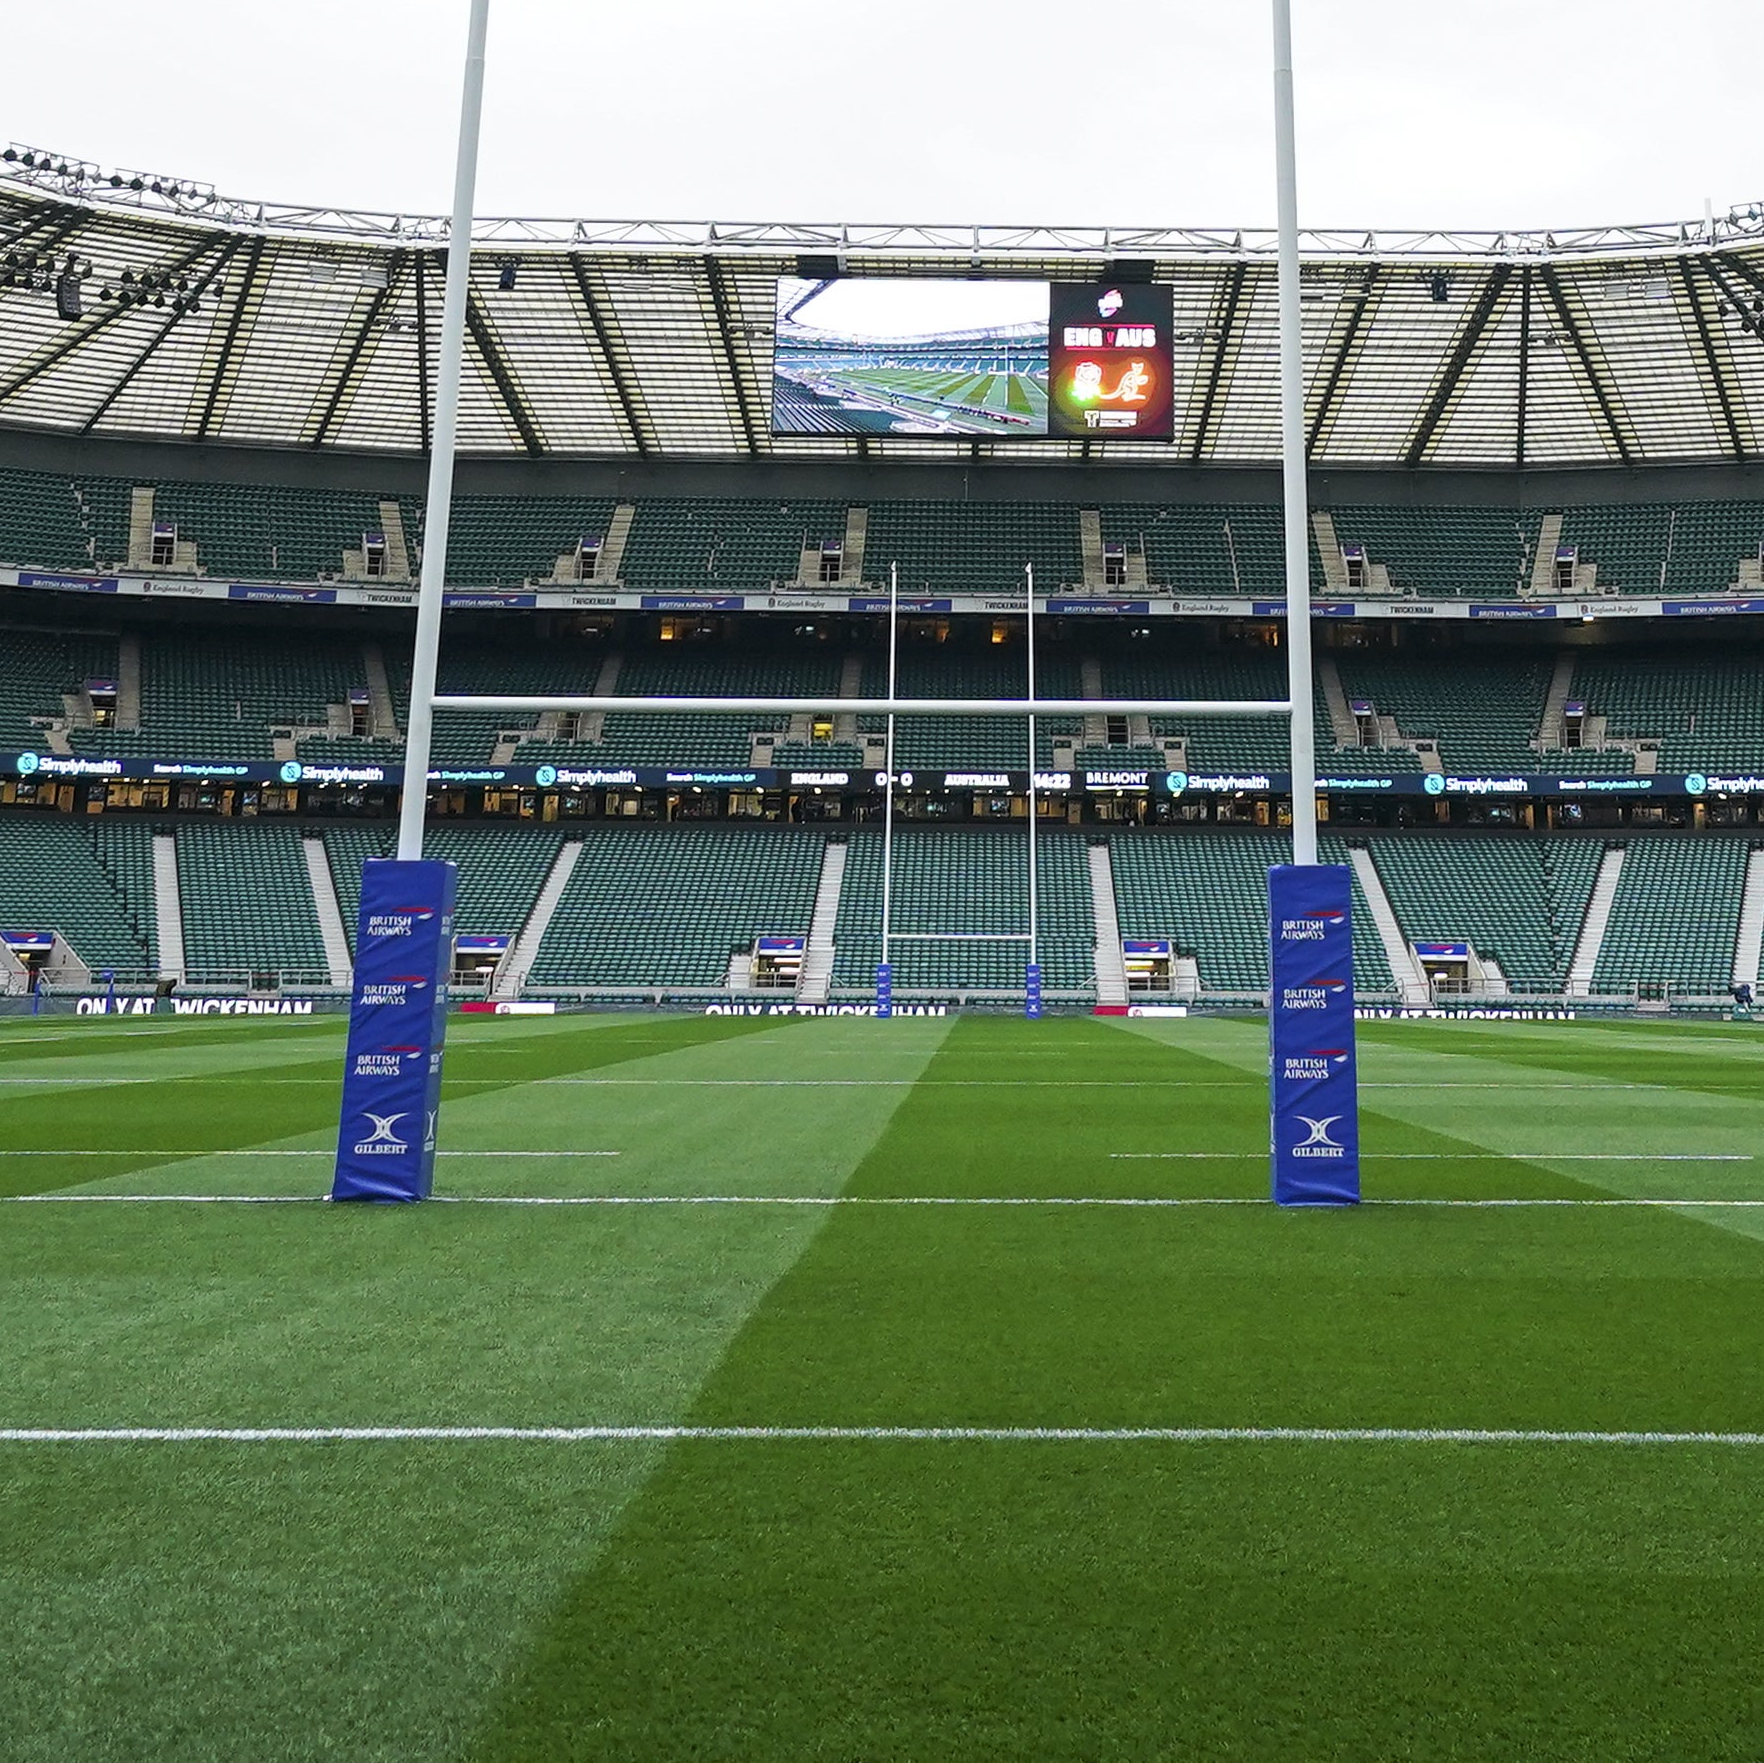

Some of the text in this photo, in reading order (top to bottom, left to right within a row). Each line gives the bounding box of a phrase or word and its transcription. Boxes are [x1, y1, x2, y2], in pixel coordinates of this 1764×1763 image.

[1064, 327, 1102, 346] ENG
[1115, 328, 1156, 347] AUS
[153, 583, 205, 595] England Rugby
[778, 599, 825, 608] England Rugby
[1181, 603, 1229, 613] England Rugby
[1590, 604, 1639, 614] England Rugby
[1389, 605, 1434, 614] TWICKENHAM
[39, 757, 121, 775] Simplyhealth
[302, 766, 384, 782] Simplyhealth
[557, 770, 636, 785] Simplyhealth
[791, 774, 848, 784] ENGLAND
[900, 773, 913, 785] 0
[945, 774, 1009, 785] AUSTRALIA
[1087, 772, 1148, 784] BREMONT
[1188, 775, 1269, 791] Simplyhealth
[1446, 778, 1528, 794] Simplyhealth
[369, 915, 412, 926] BRITISH
[1282, 920, 1324, 930] BRITISH
[367, 925, 411, 936] AIRWAYS
[1281, 929, 1325, 940] AIRWAYS
[363, 985, 406, 995] BRITISH
[1284, 989, 1326, 999] BRITISH
[361, 994, 406, 1005] AIRWAYS
[1282, 998, 1326, 1008] AIRWAYS
[77, 998, 130, 1014] ONY
[358, 1055, 400, 1065] BRITISH
[1285, 1059, 1328, 1069] BRITISH
[354, 1064, 400, 1076] AIRWAYS
[1284, 1068, 1329, 1079] AIRWAYS
[354, 1144, 407, 1155] GILBERT
[1292, 1147, 1344, 1157] GILBERT
